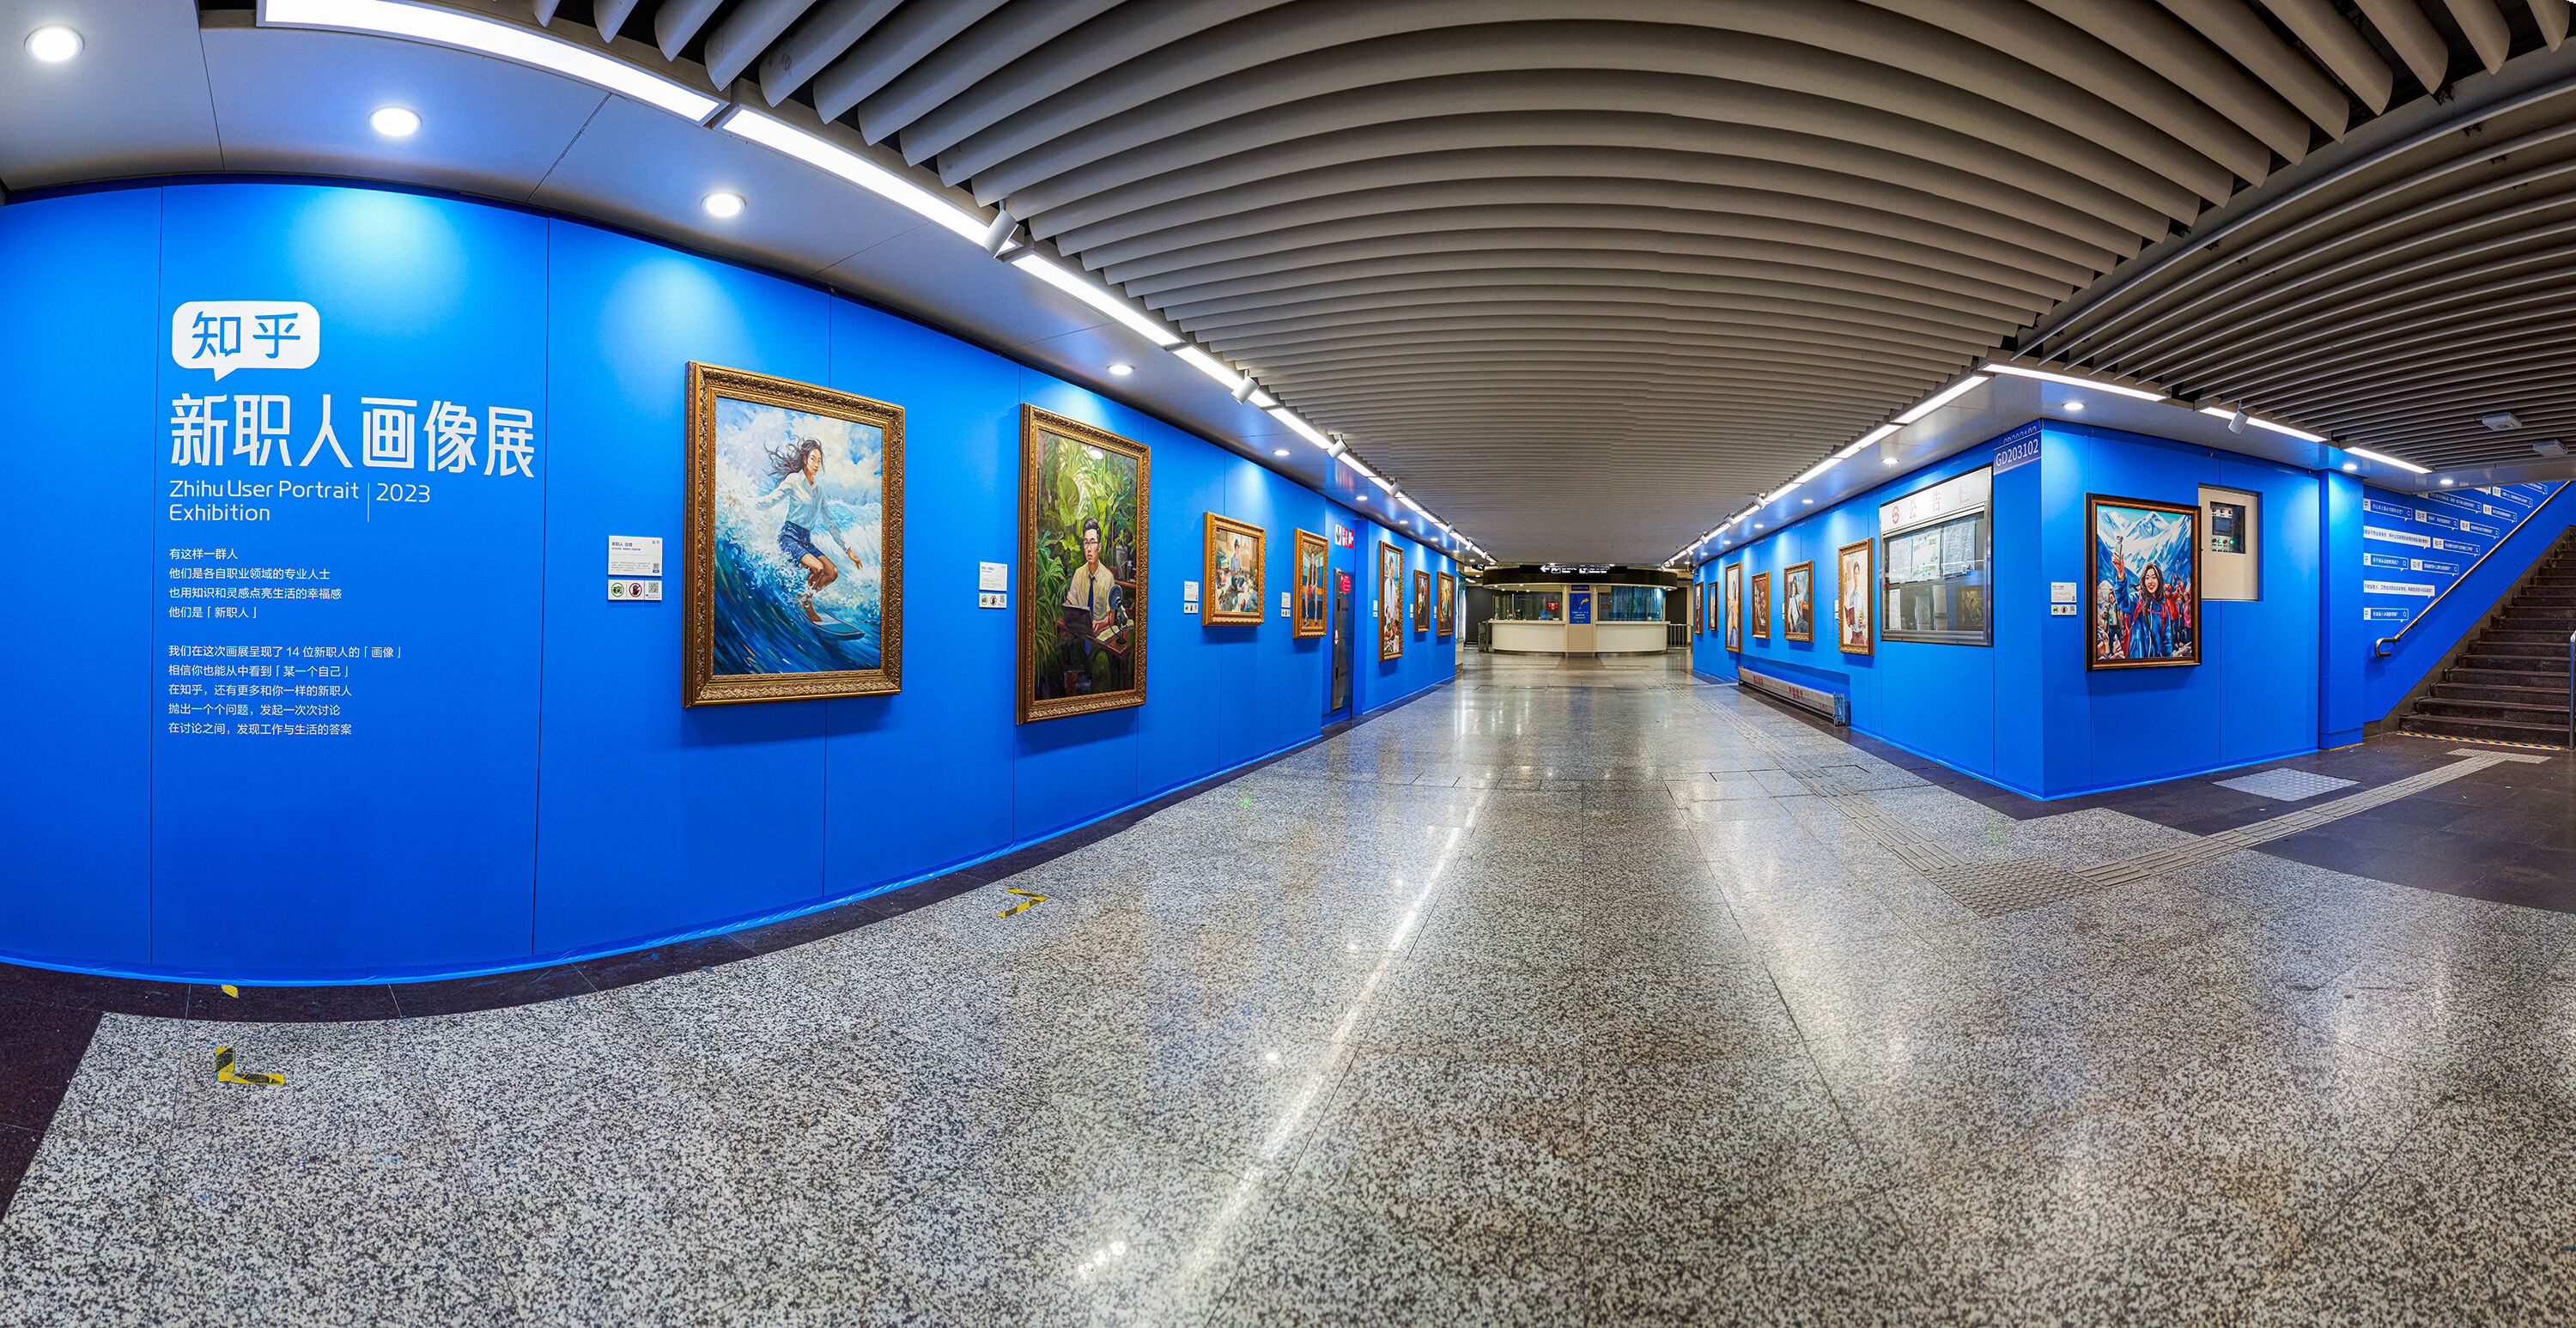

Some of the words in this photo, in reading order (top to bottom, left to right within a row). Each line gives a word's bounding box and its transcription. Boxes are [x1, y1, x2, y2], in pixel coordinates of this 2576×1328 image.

[191, 311, 301, 359] 知乎
[170, 392, 535, 478] 新职人画像展
[1996, 439, 2039, 467] GD203102
[169, 480, 223, 498] Zhihu
[227, 480, 274, 498] User
[279, 480, 360, 500] Portrait
[375, 482, 430, 503] 2023
[169, 503, 270, 521] Exhibition
[169, 548, 239, 560] 有这样一群人
[168, 567, 331, 580] 他们是各自职业领域的专业人士
[168, 586, 343, 600] 也用知识和灵感点亮生活的幸福感
[168, 646, 283, 658] 我们在这次画展呈现了
[286, 647, 300, 658] 14
